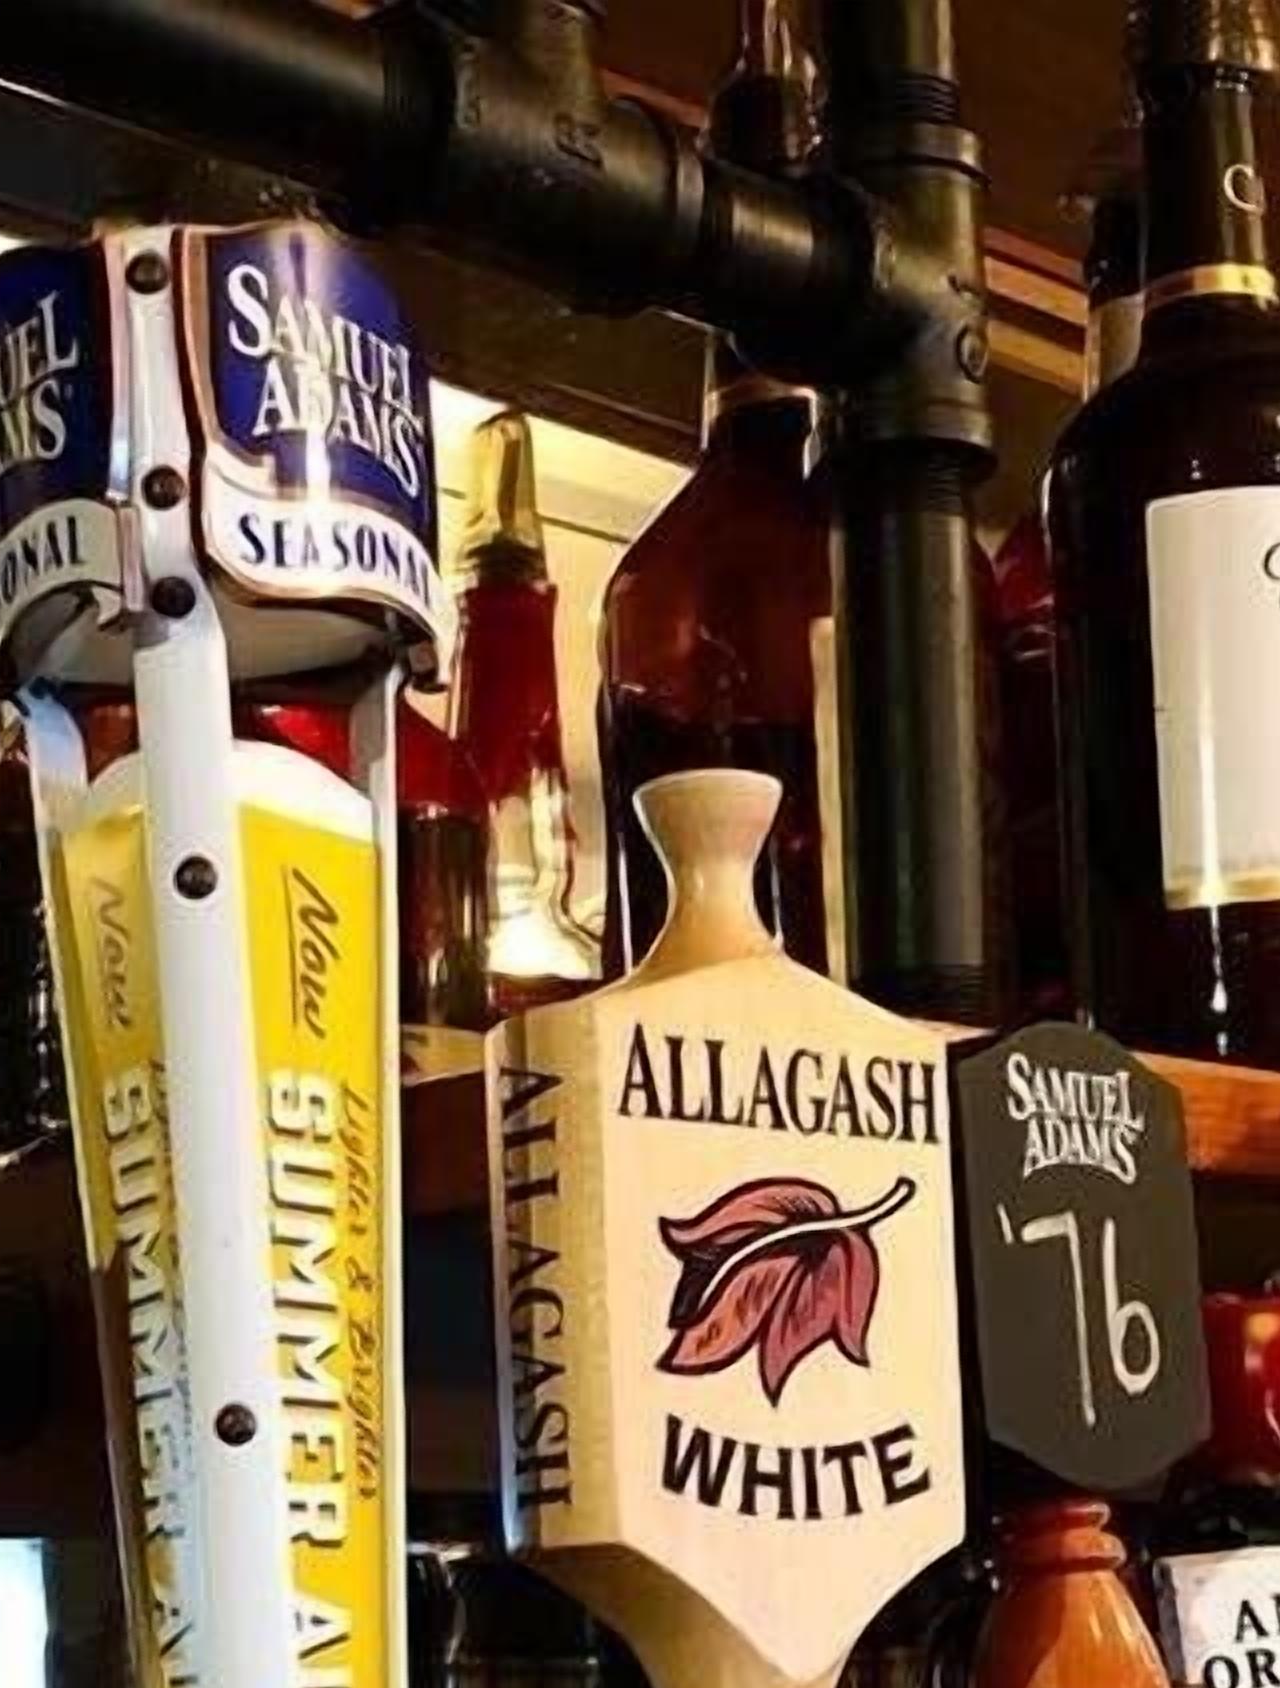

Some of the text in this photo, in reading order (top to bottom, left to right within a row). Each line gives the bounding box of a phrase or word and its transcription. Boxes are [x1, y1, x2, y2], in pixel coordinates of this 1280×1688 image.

[227, 264, 412, 413] SAMUEL
[252, 355, 425, 498] ADAMS
[290, 866, 342, 1040] Now
[617, 1021, 941, 1146] ALLAGASH
[1006, 1052, 1146, 1132] SAMUEL
[1022, 1116, 1138, 1186] ADAMS
[266, 1070, 348, 1549] SUMMER
[339, 1081, 377, 1501] Lighter & Brighter
[498, 1064, 573, 1510] ALLAGASH
[660, 1412, 933, 1521] WHITE
